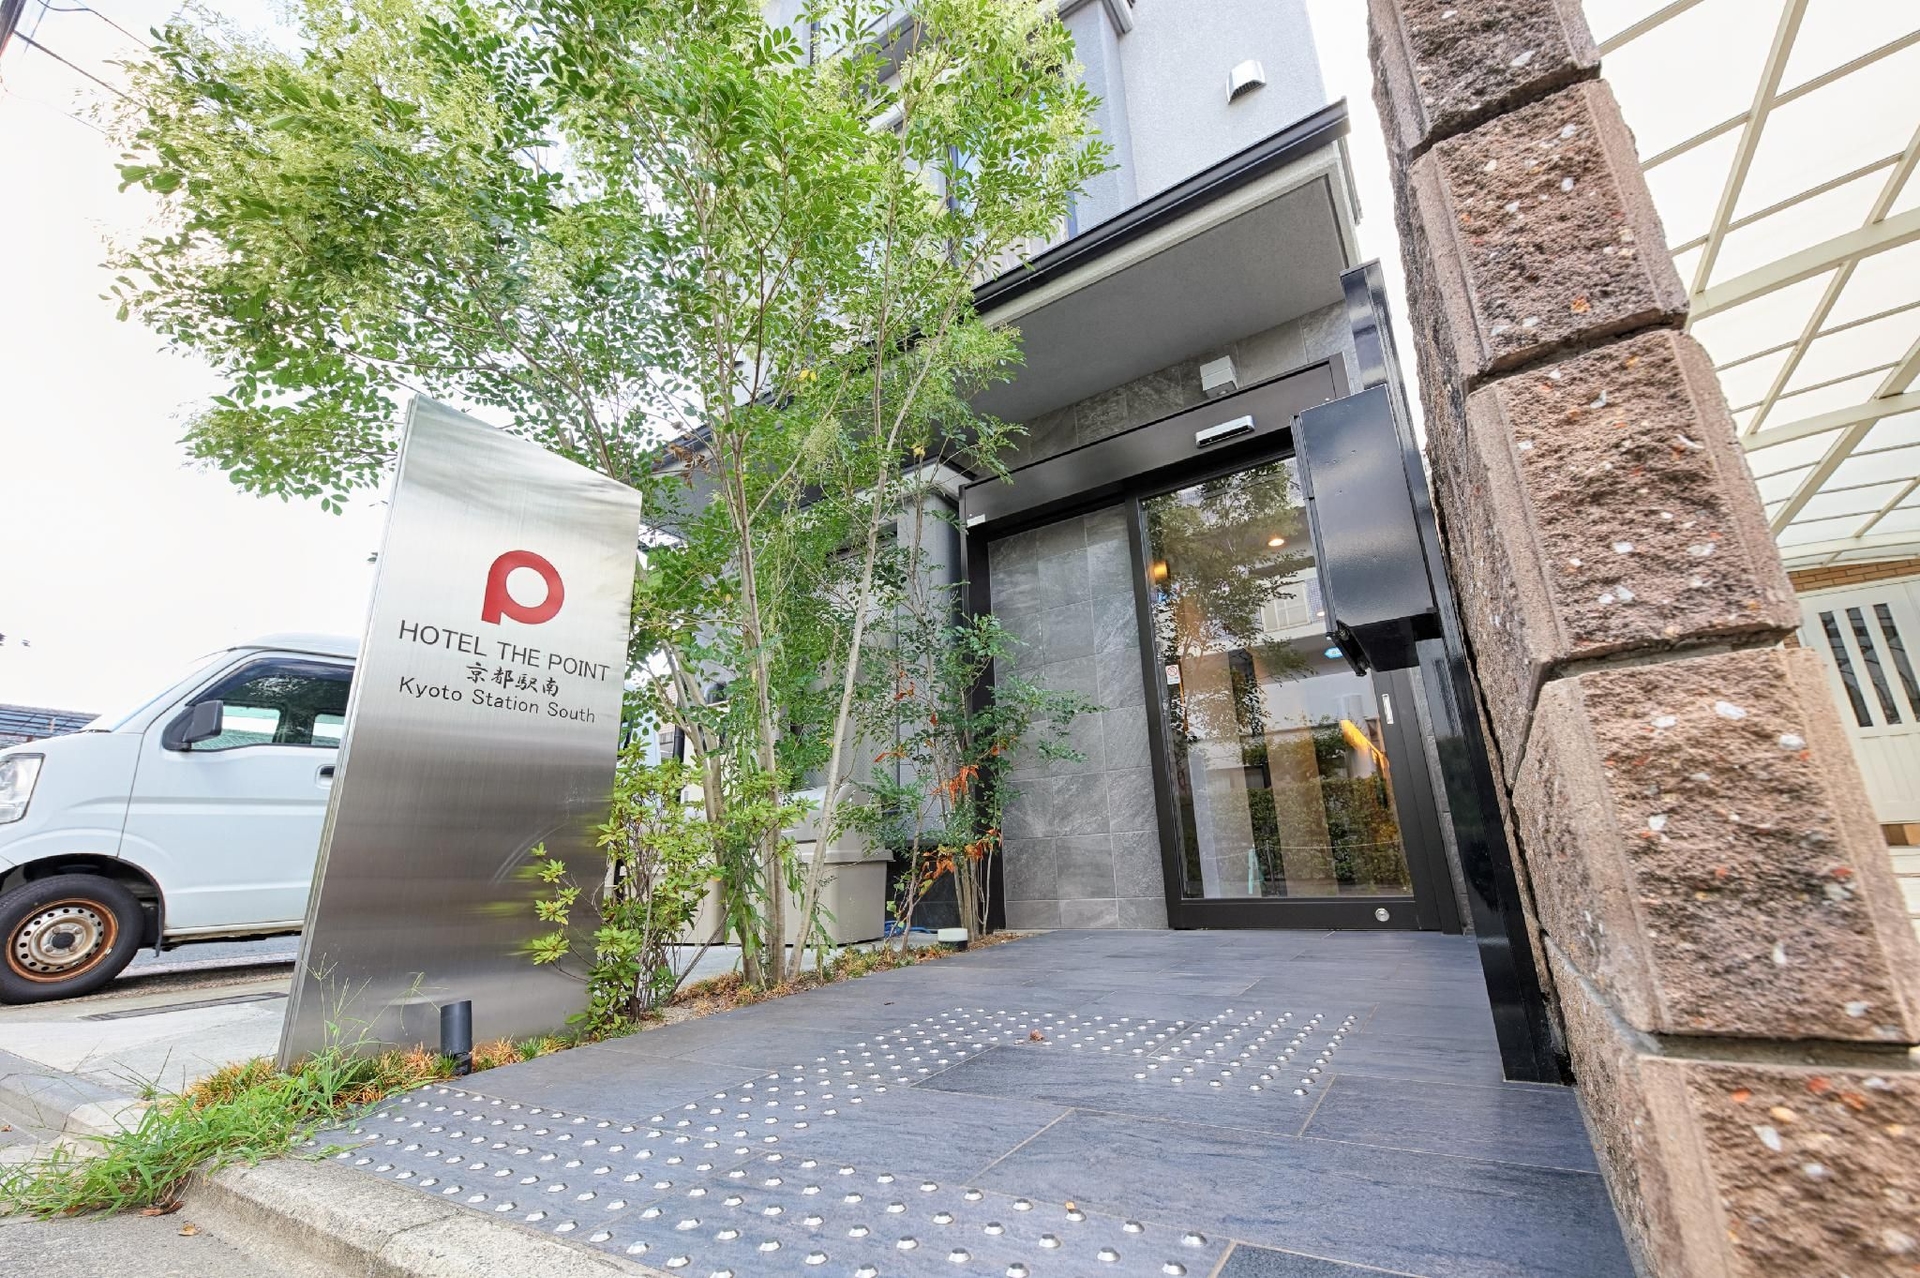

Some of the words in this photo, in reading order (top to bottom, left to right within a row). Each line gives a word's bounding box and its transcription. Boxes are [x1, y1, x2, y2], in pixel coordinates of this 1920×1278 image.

[399, 619, 487, 657] HOTEL
[497, 641, 541, 668] THE
[547, 653, 611, 681] POINT
[399, 676, 462, 701] Kyoto
[471, 688, 539, 714] Station
[547, 701, 596, 723] South
[466, 661, 559, 697] 京都駅南
